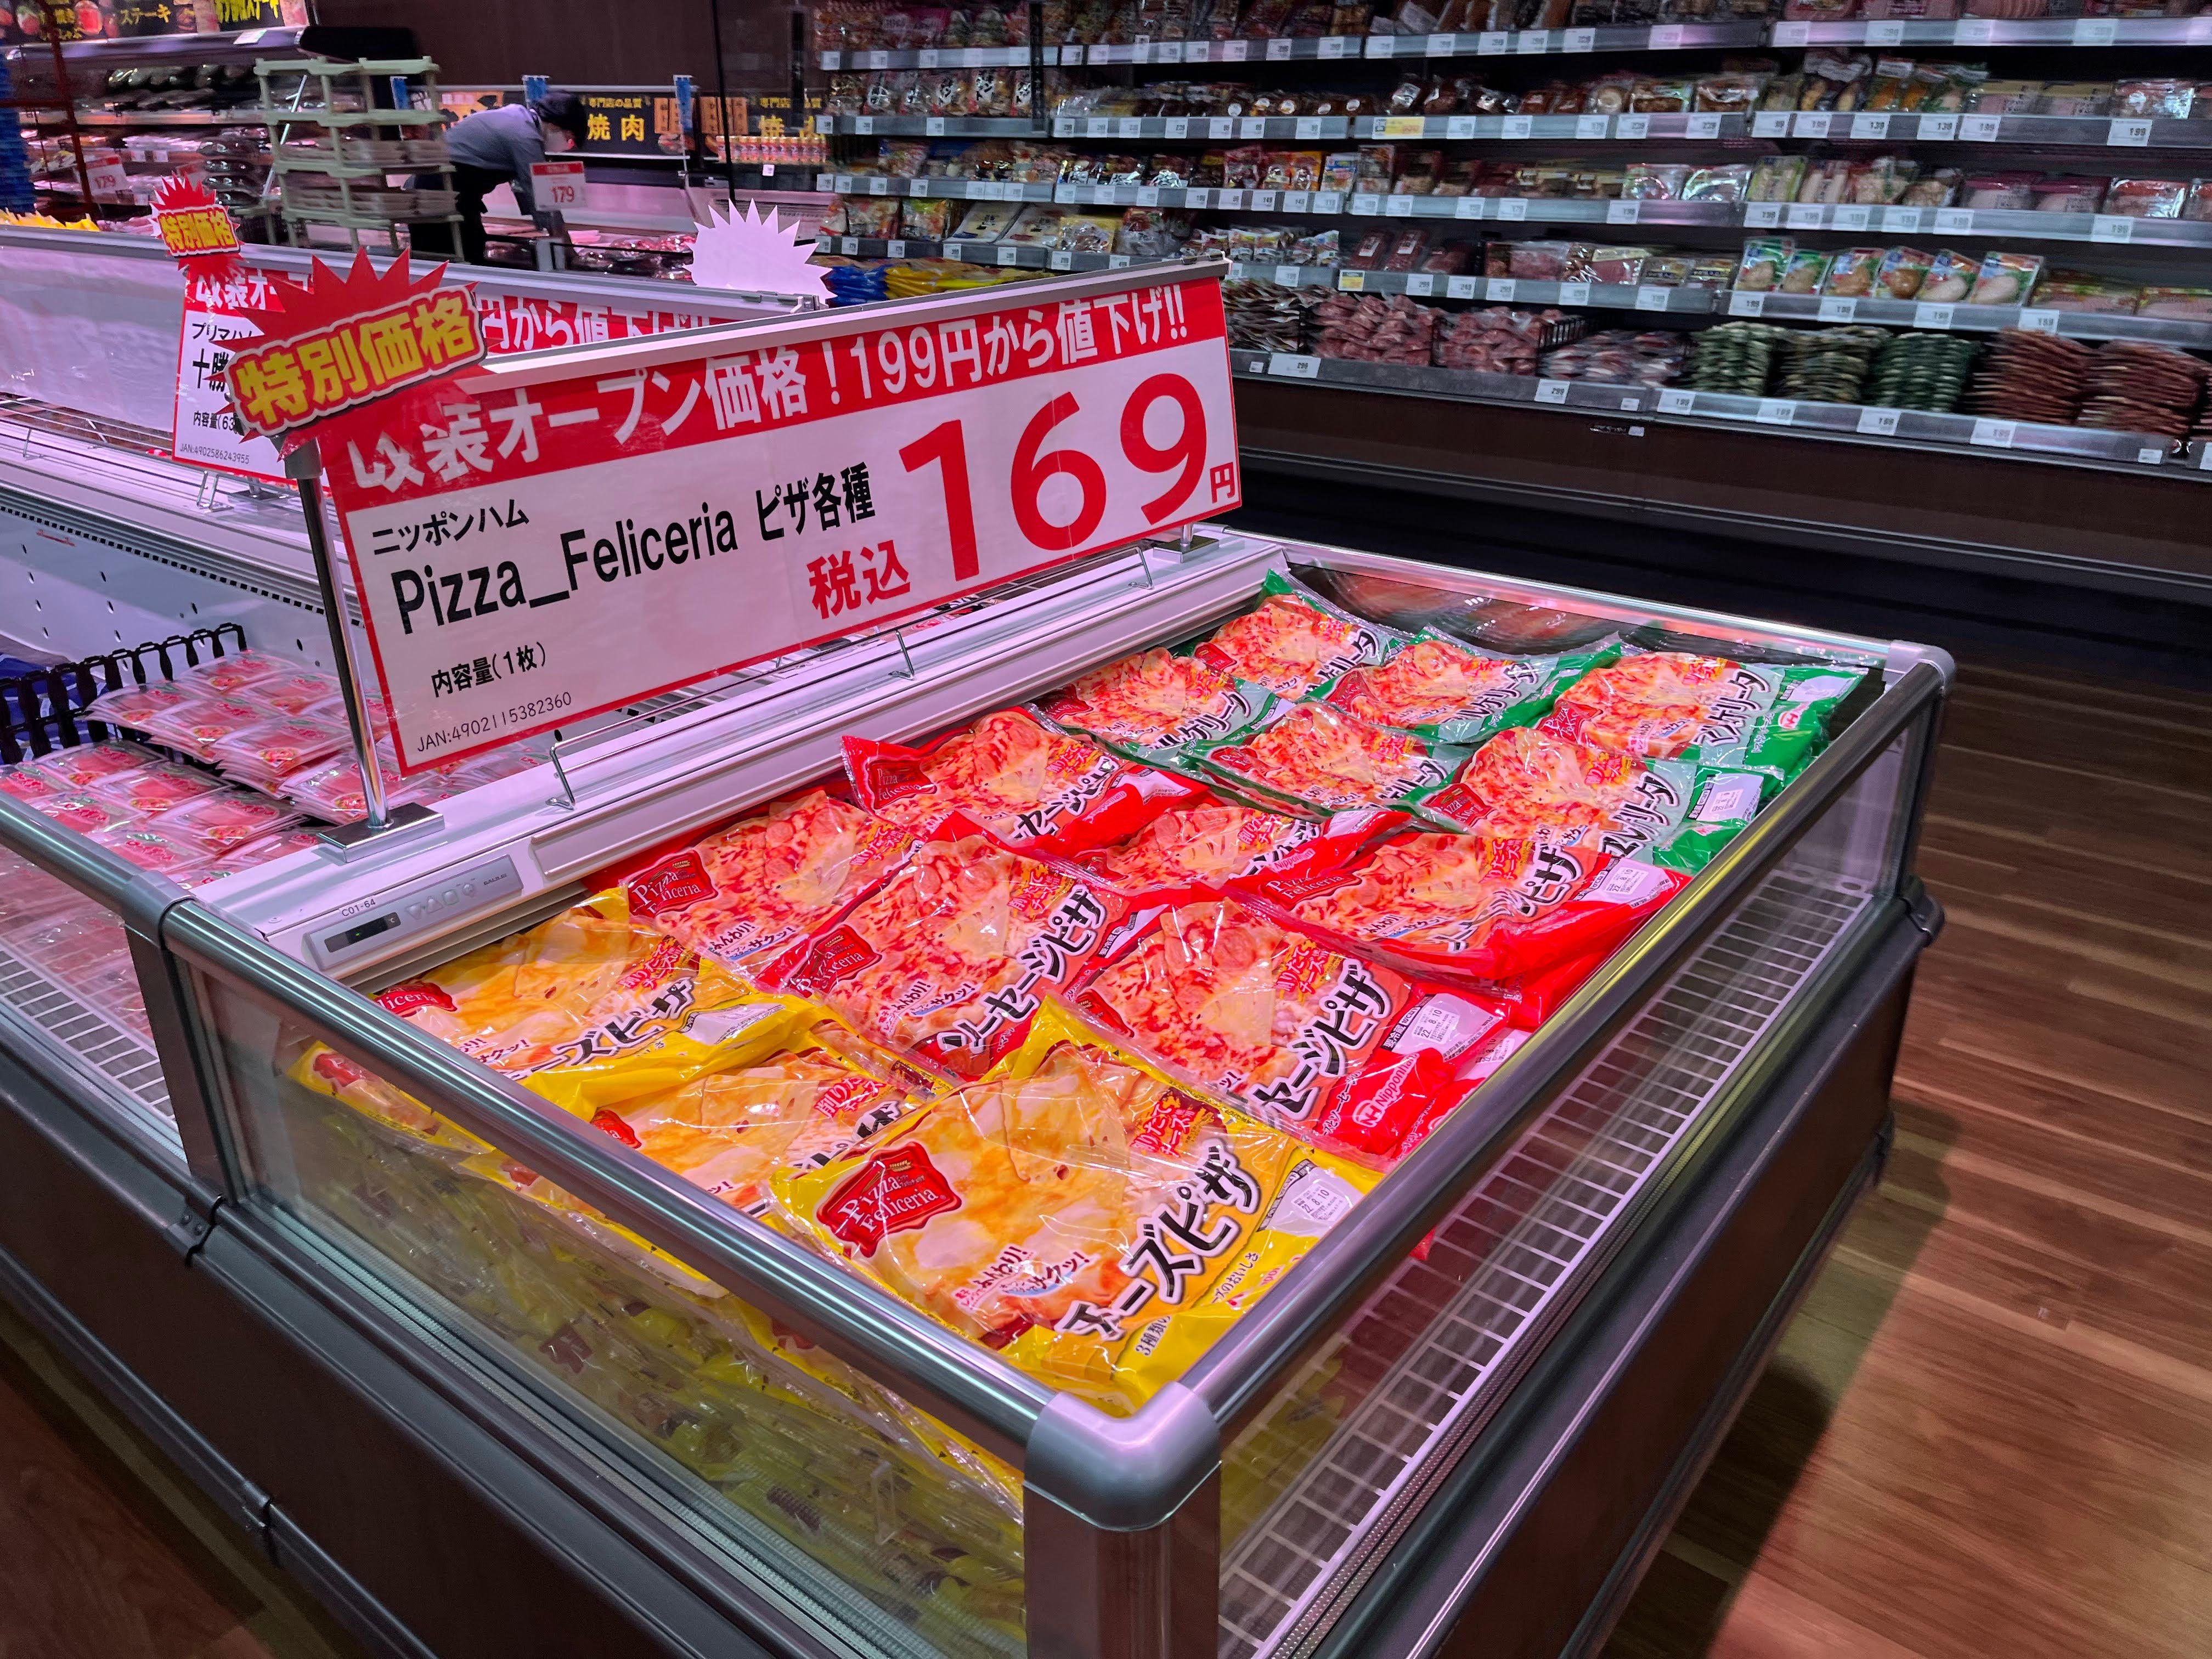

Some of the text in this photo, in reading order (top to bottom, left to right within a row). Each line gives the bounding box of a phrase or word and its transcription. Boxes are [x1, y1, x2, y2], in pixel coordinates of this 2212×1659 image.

[161, 210, 238, 250] 特別価格
[192, 321, 255, 342] プリマハ
[236, 297, 475, 425] 特別価格
[806, 373, 1235, 620] 税込 169 円
[371, 499, 529, 555] ニッポンハム
[391, 461, 876, 634] Pizza_Feliceria ピザ各種
[431, 641, 546, 698] 内容量(1枚)
[417, 691, 572, 752] JAN:4902115382360
[341, 898, 376, 917] C01-64
[837, 1175, 902, 1224] Pizza
[859, 1188, 939, 1233] Feliceria
[1063, 1144, 1252, 1336] チーズピザ
